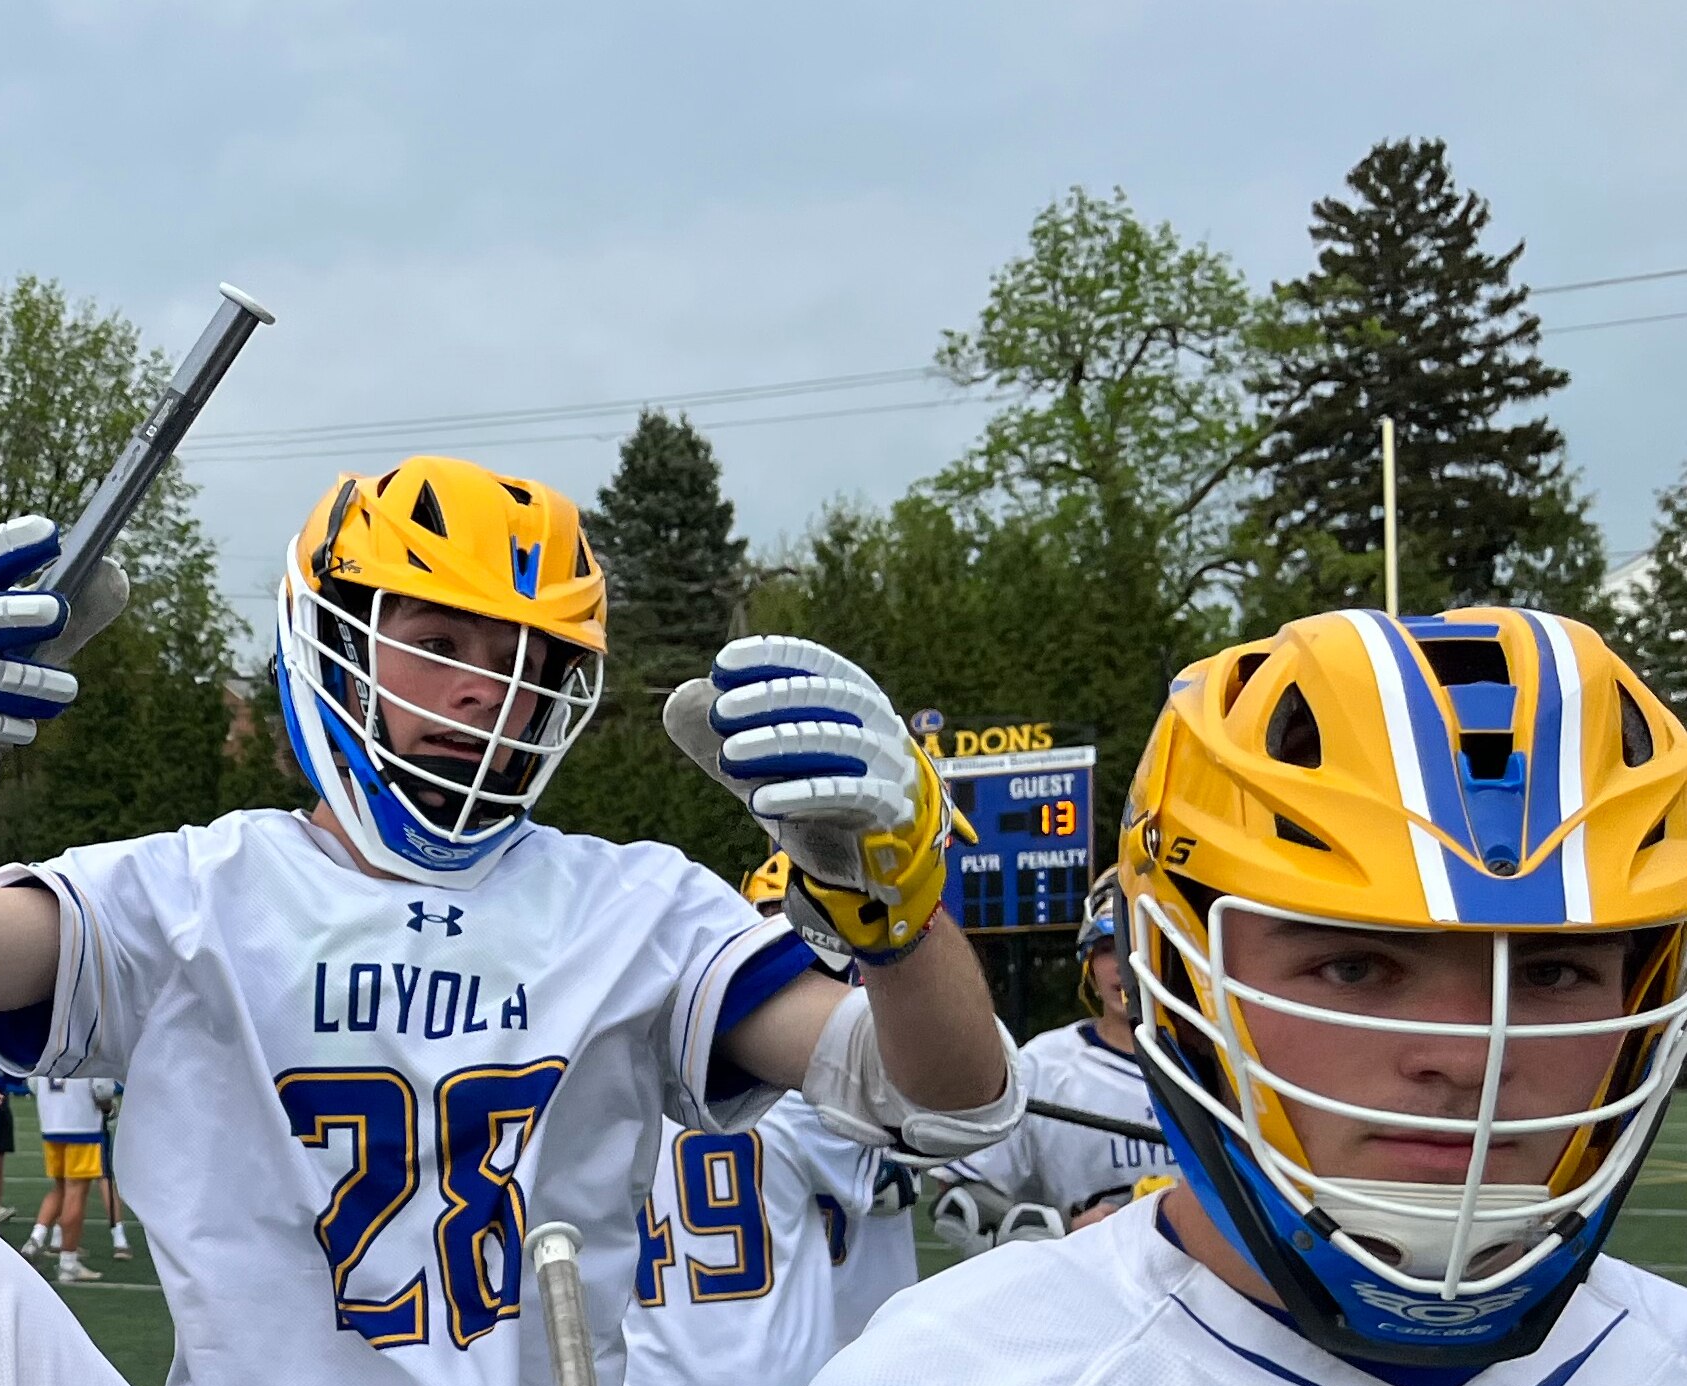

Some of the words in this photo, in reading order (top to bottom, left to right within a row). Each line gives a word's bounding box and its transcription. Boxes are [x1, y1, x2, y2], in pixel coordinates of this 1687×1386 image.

[954, 722, 1054, 758] DONS
[1009, 773, 1075, 800] GUEST
[1040, 800, 1077, 836] 13
[960, 853, 1001, 874] PLYR
[1016, 848, 1088, 871] PENALTY
[314, 961, 529, 1040] LOYOLA
[275, 1056, 568, 1350] 28
